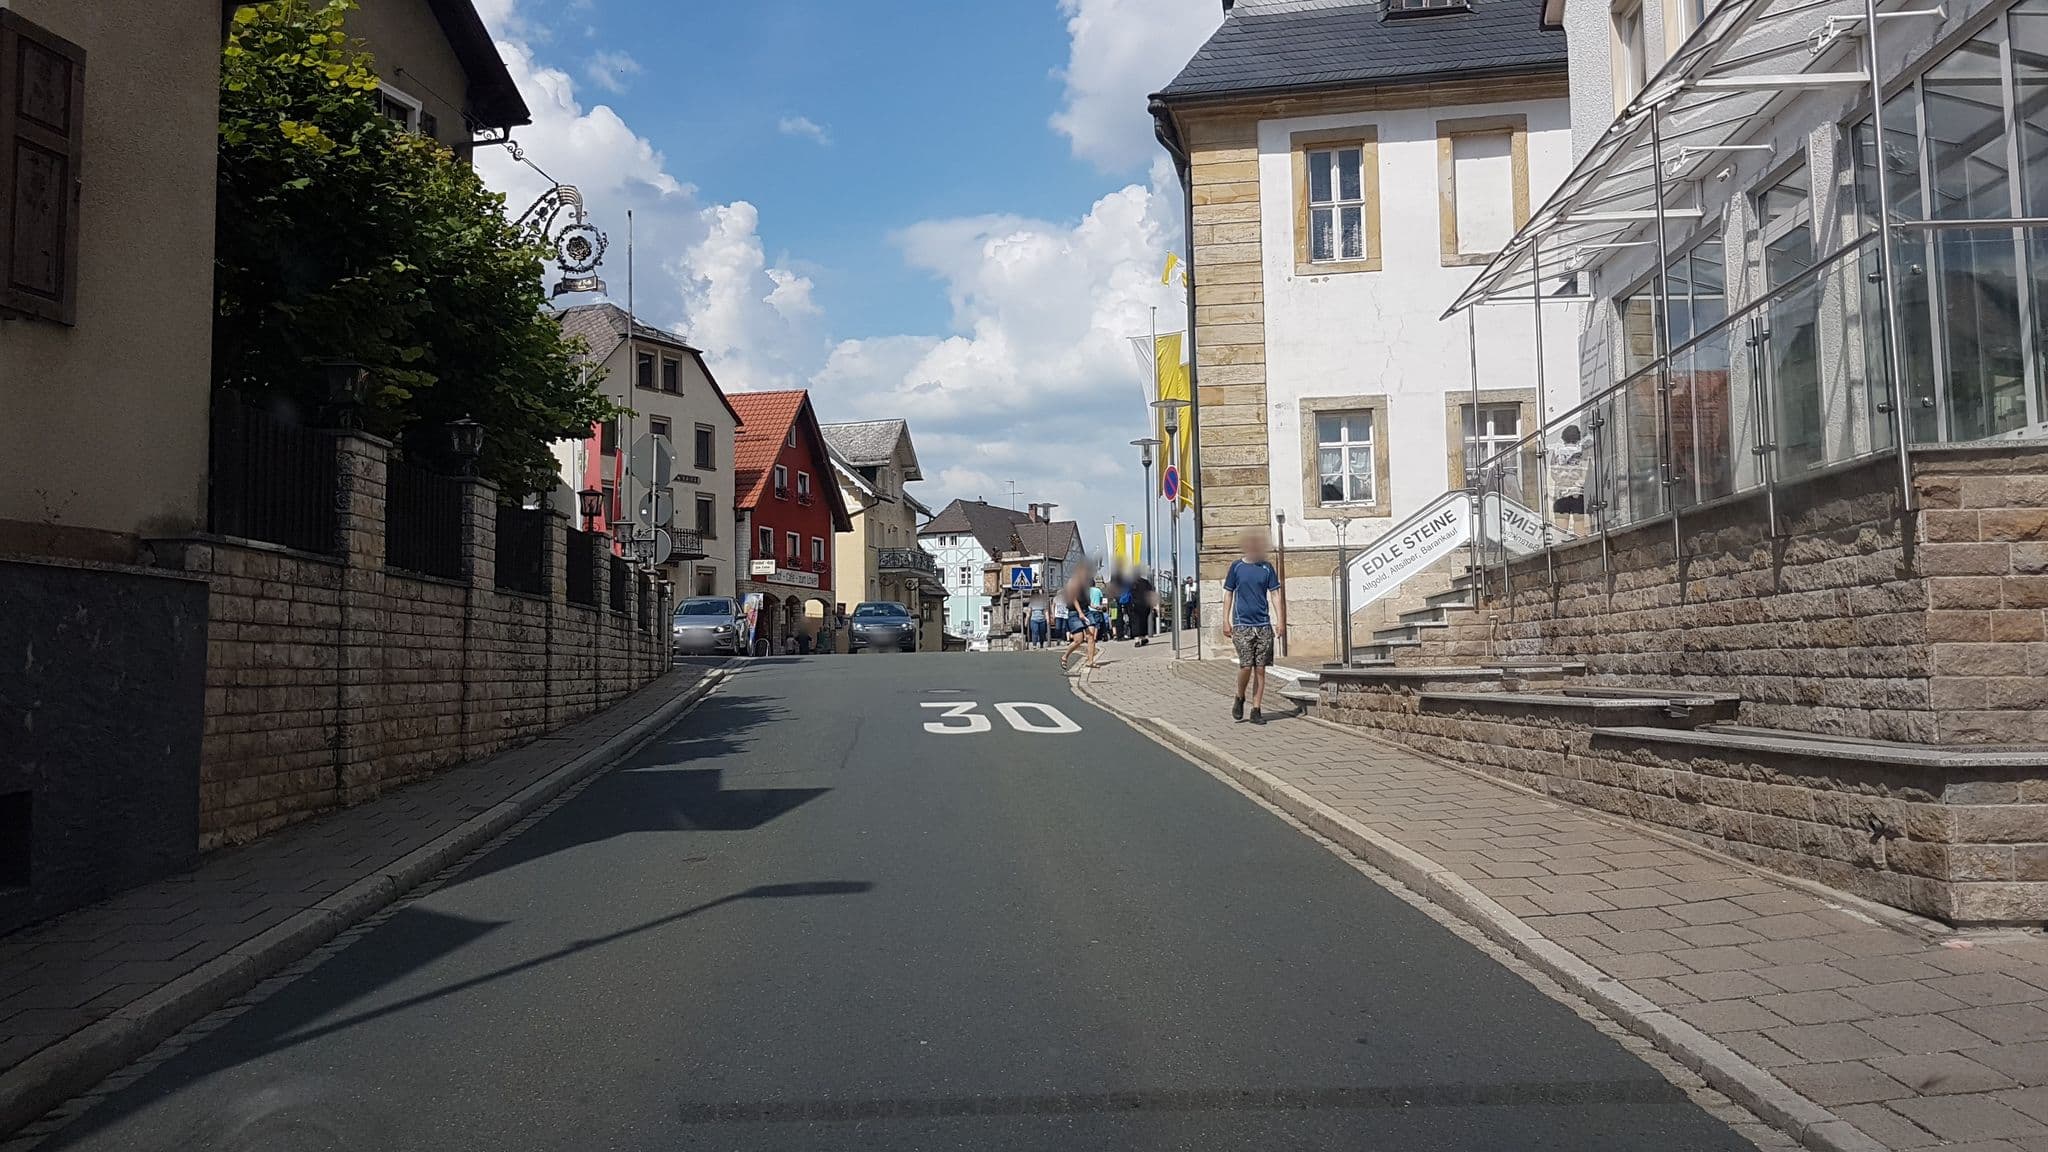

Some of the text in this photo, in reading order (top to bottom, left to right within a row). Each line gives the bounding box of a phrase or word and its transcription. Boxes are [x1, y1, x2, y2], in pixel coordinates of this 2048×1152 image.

[1362, 509, 1457, 576] EDLE STEINE
[1362, 572, 1390, 592] Altgold,
[1420, 526, 1458, 555] Barankauf
[920, 702, 1083, 734] 30
